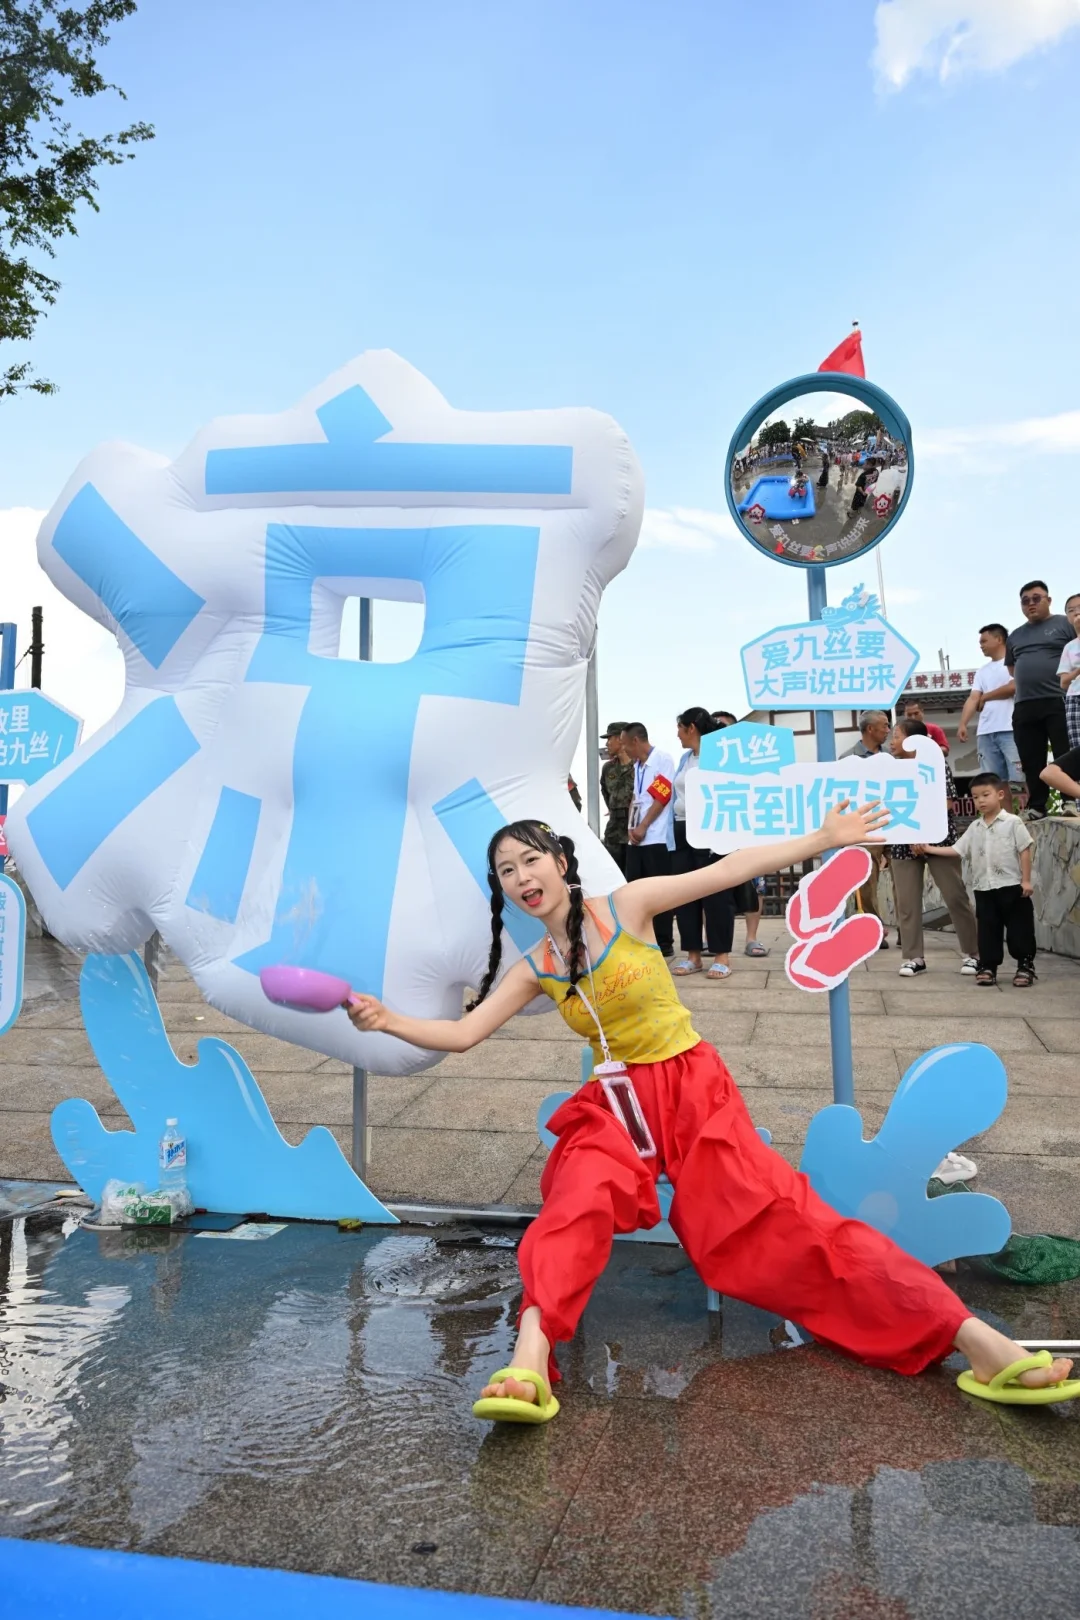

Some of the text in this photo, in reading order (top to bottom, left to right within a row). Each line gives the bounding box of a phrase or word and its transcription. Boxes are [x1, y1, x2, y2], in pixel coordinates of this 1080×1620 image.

[762, 629, 886, 671] 爱九丝要
[26, 384, 573, 1004] 凉
[754, 664, 896, 698] 大声说出来
[716, 732, 781, 767] 九丝
[700, 778, 921, 836] 凉到你没
